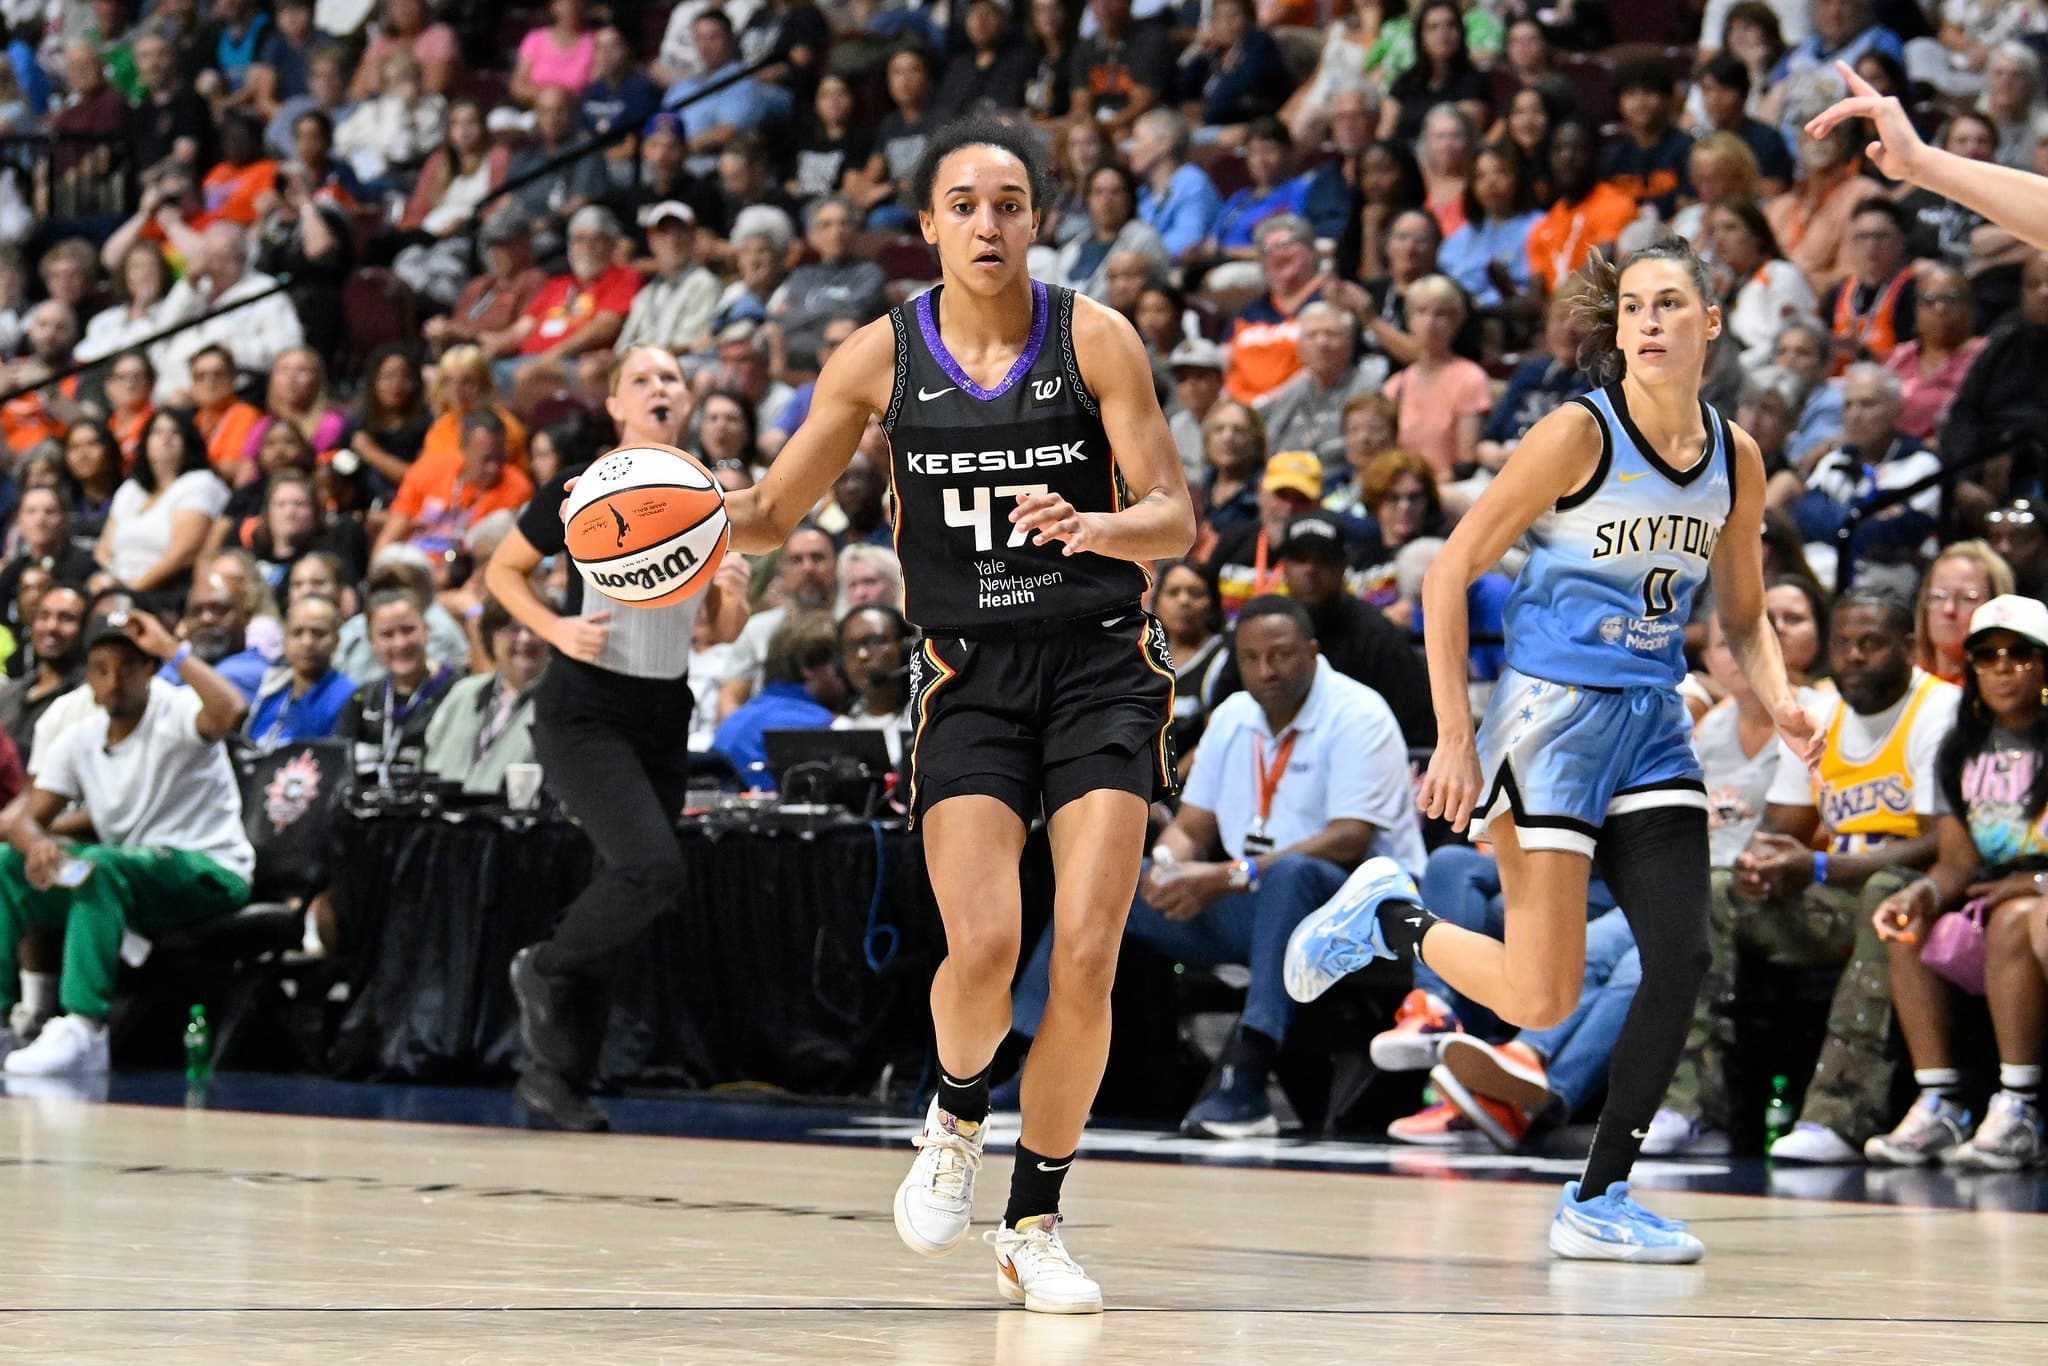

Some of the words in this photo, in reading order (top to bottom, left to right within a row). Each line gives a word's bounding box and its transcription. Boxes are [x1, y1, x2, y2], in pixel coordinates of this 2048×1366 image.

[907, 440, 1089, 475] KEESUSK
[942, 484, 1049, 552] 47
[590, 545, 699, 589] Wilson
[974, 558, 1006, 576] Yale
[979, 570, 1063, 593] NewHaven
[979, 590, 1035, 609] Health
[1643, 567, 1678, 620] 0
